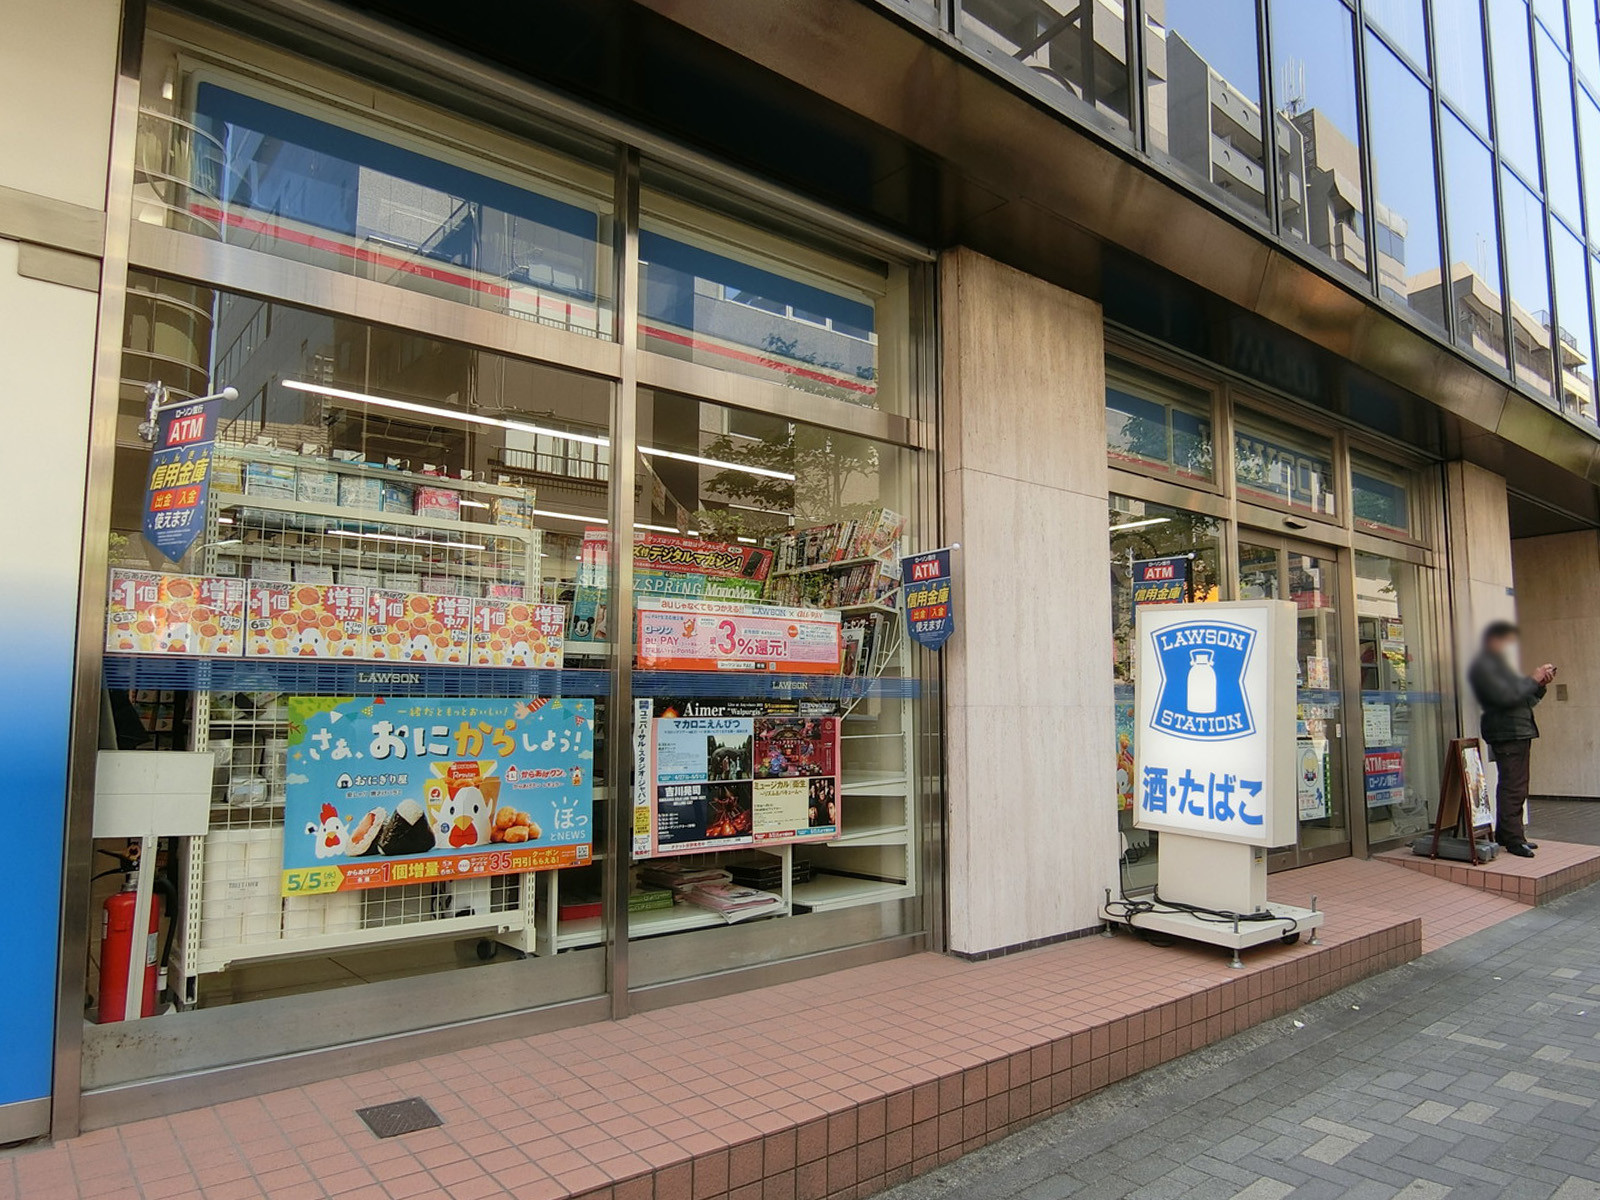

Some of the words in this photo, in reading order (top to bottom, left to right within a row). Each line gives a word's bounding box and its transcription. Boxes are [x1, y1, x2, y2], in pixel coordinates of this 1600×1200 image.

[174, 404, 204, 418] ローソン銀行
[169, 418, 204, 443] ATM
[150, 457, 210, 491] 信用金庫
[154, 493, 173, 509] 出金
[177, 490, 197, 505] 入金
[154, 509, 193, 530] 使えます!
[914, 562, 939, 579] ATM
[1145, 567, 1174, 580] ATM
[201, 579, 243, 602] 増量
[327, 587, 364, 608] 増量
[705, 583, 757, 599] MonoMax
[907, 588, 949, 608] 信用金庫
[1134, 585, 1182, 602] 信用金庫
[437, 597, 470, 617] 増量
[535, 605, 564, 624] 増量
[751, 607, 786, 616] LAWSON
[932, 607, 945, 617] 入金
[660, 636, 679, 645] PAY
[1161, 629, 1246, 651] LAWSON
[359, 673, 420, 684] LAWSON
[772, 680, 808, 690] LAWSON
[683, 702, 726, 717] Aimer
[673, 720, 740, 729] マカロニえんぴつ
[1161, 709, 1243, 733] STATION
[354, 773, 408, 786] おにぎり屋
[520, 769, 563, 779] からあげクン
[1369, 775, 1398, 788] ローソン銀行
[754, 781, 789, 790] ミュージカル
[1142, 765, 1264, 826] 酒・たばこ
[554, 808, 588, 829] ほっ
[550, 830, 586, 841] とNEWS
[532, 849, 559, 858] クーポン
[347, 867, 381, 876] からあげクン
[381, 861, 439, 882] 1個増量
[287, 872, 321, 891] 5/5
